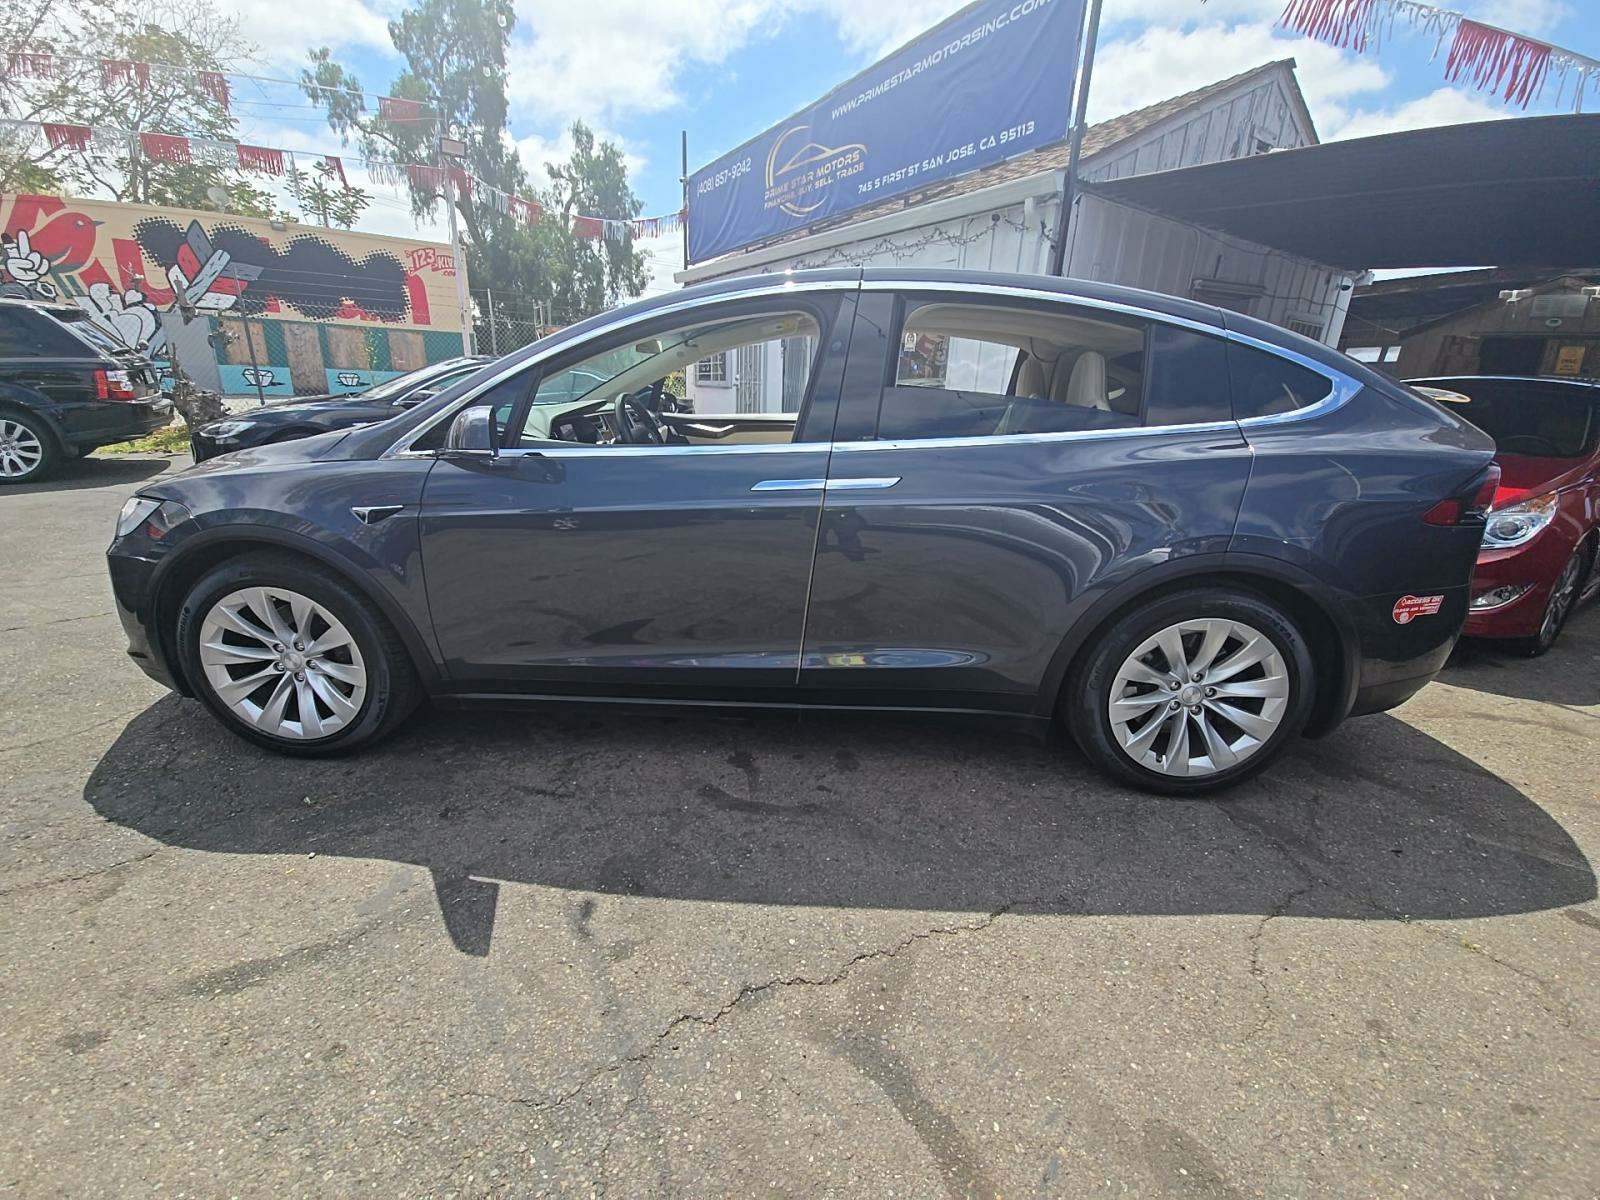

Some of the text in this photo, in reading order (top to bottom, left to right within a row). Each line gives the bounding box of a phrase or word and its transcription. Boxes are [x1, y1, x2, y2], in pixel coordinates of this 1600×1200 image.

[697, 157, 752, 198] (408) 857-9242
[764, 149, 860, 200] PRIME STAR MOTORS
[836, 161, 865, 180] TRADE
[857, 120, 1036, 195] 745 S FIRST ST SAN JOSE, CA 95113
